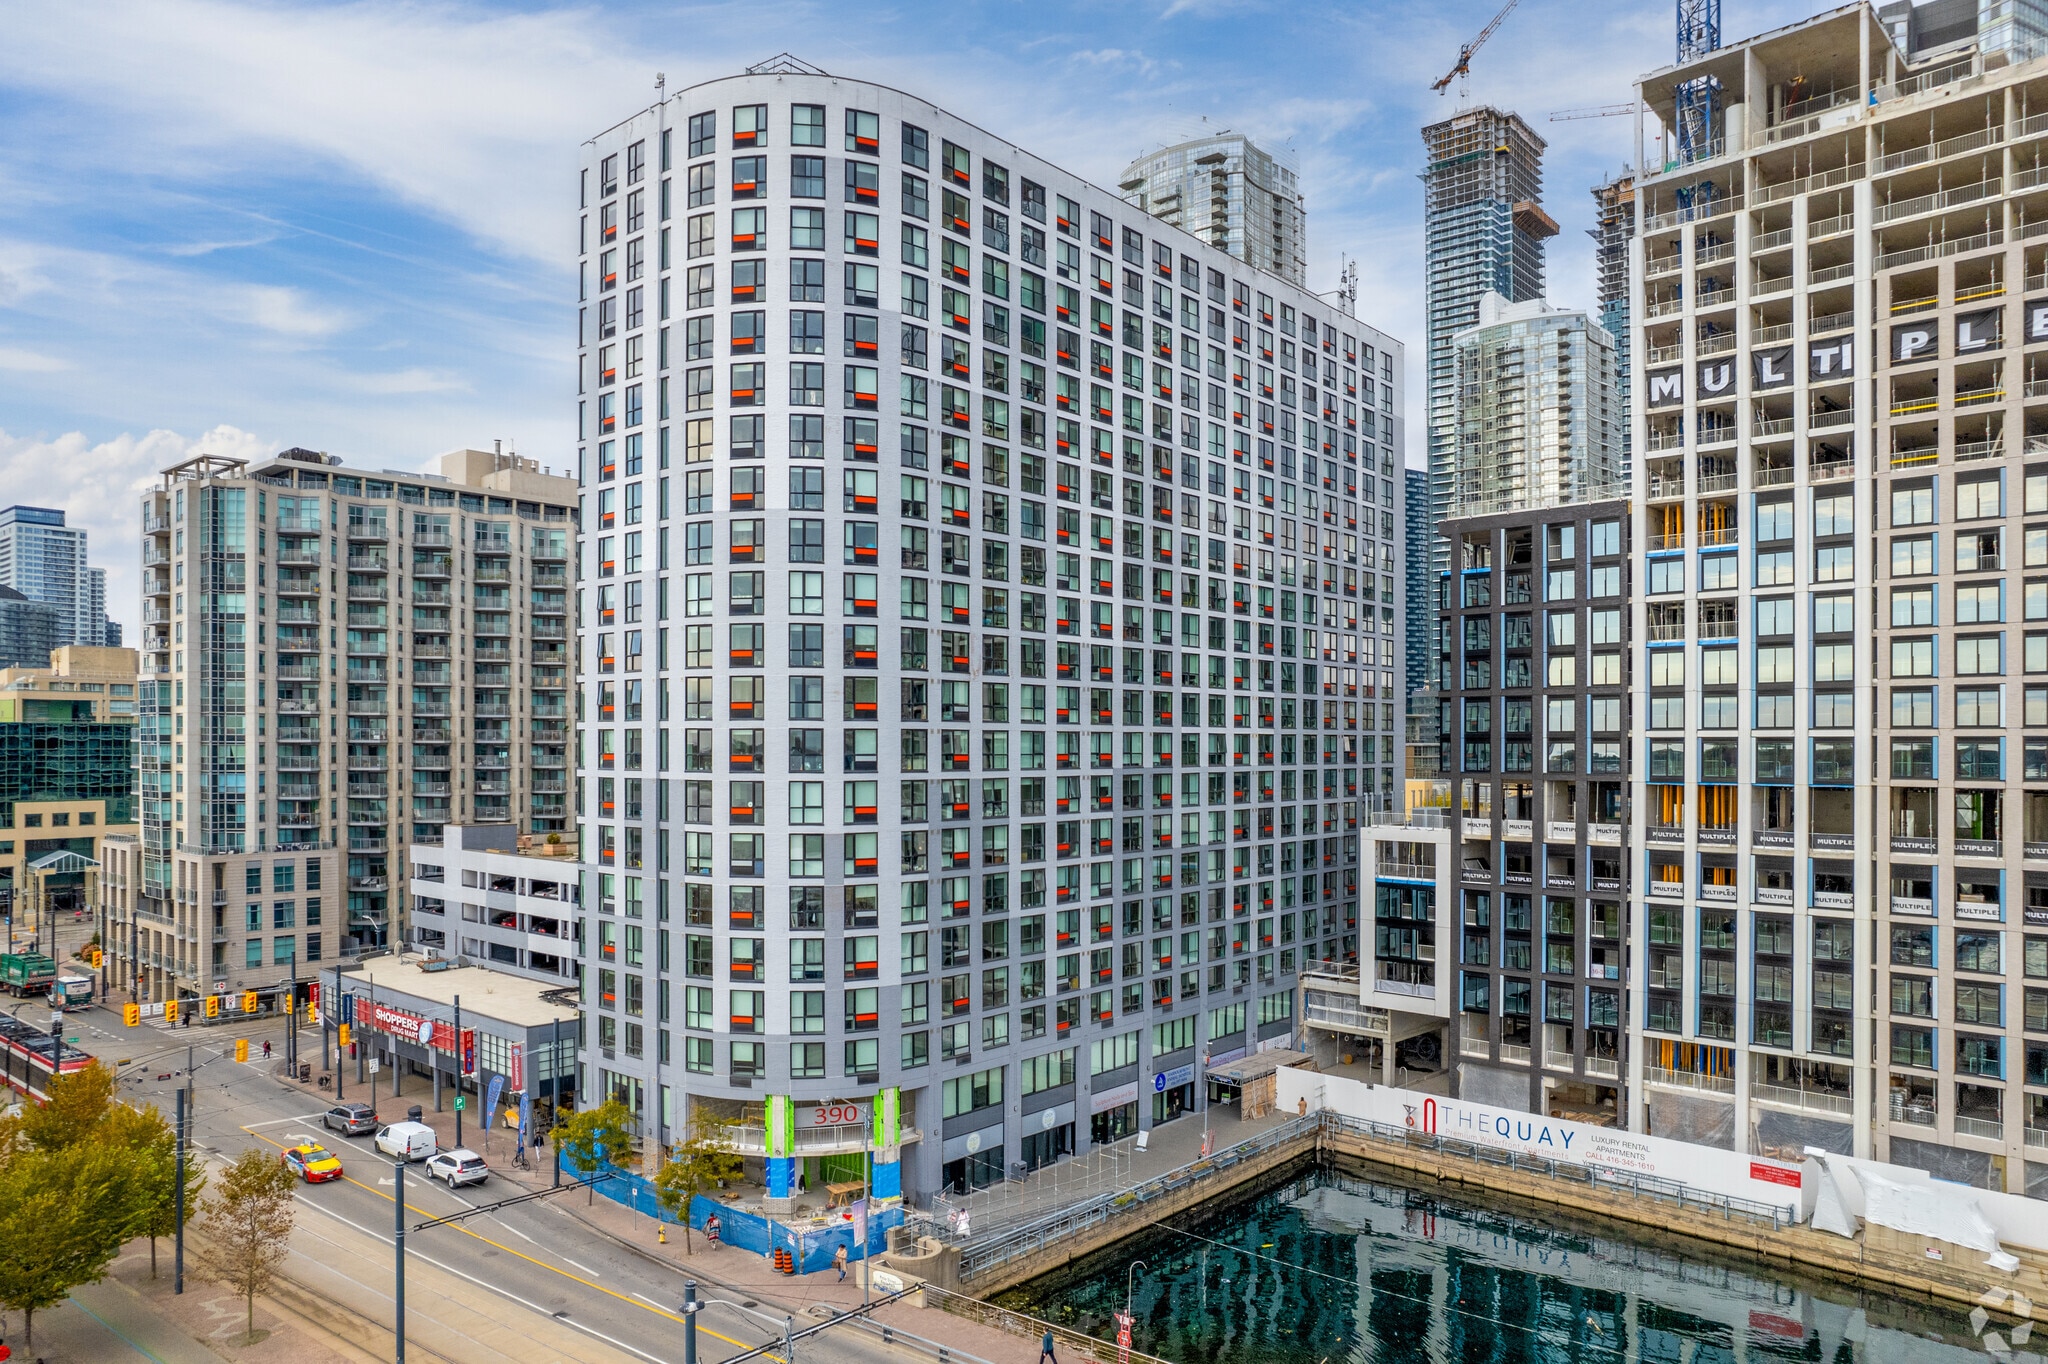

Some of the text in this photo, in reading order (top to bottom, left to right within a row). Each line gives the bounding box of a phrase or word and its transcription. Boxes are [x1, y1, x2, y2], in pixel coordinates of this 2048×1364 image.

[1817, 838, 1855, 846] MULTIPLE
[1890, 840, 1936, 850] MULTIPLEX
[375, 1008, 419, 1032] SHOPPERS
[390, 1025, 419, 1040] DRUG MART
[456, 1098, 463, 1106] P
[814, 1105, 858, 1125] 390
[1445, 1129, 1569, 1160] Premium Waterfront Apartments
[1591, 1135, 1651, 1153] LUXURY RENTAL
[1585, 1151, 1604, 1161] CALL
[1606, 1155, 1655, 1171] 416-345-1610
[1595, 1145, 1646, 1161] APARTMENTS
